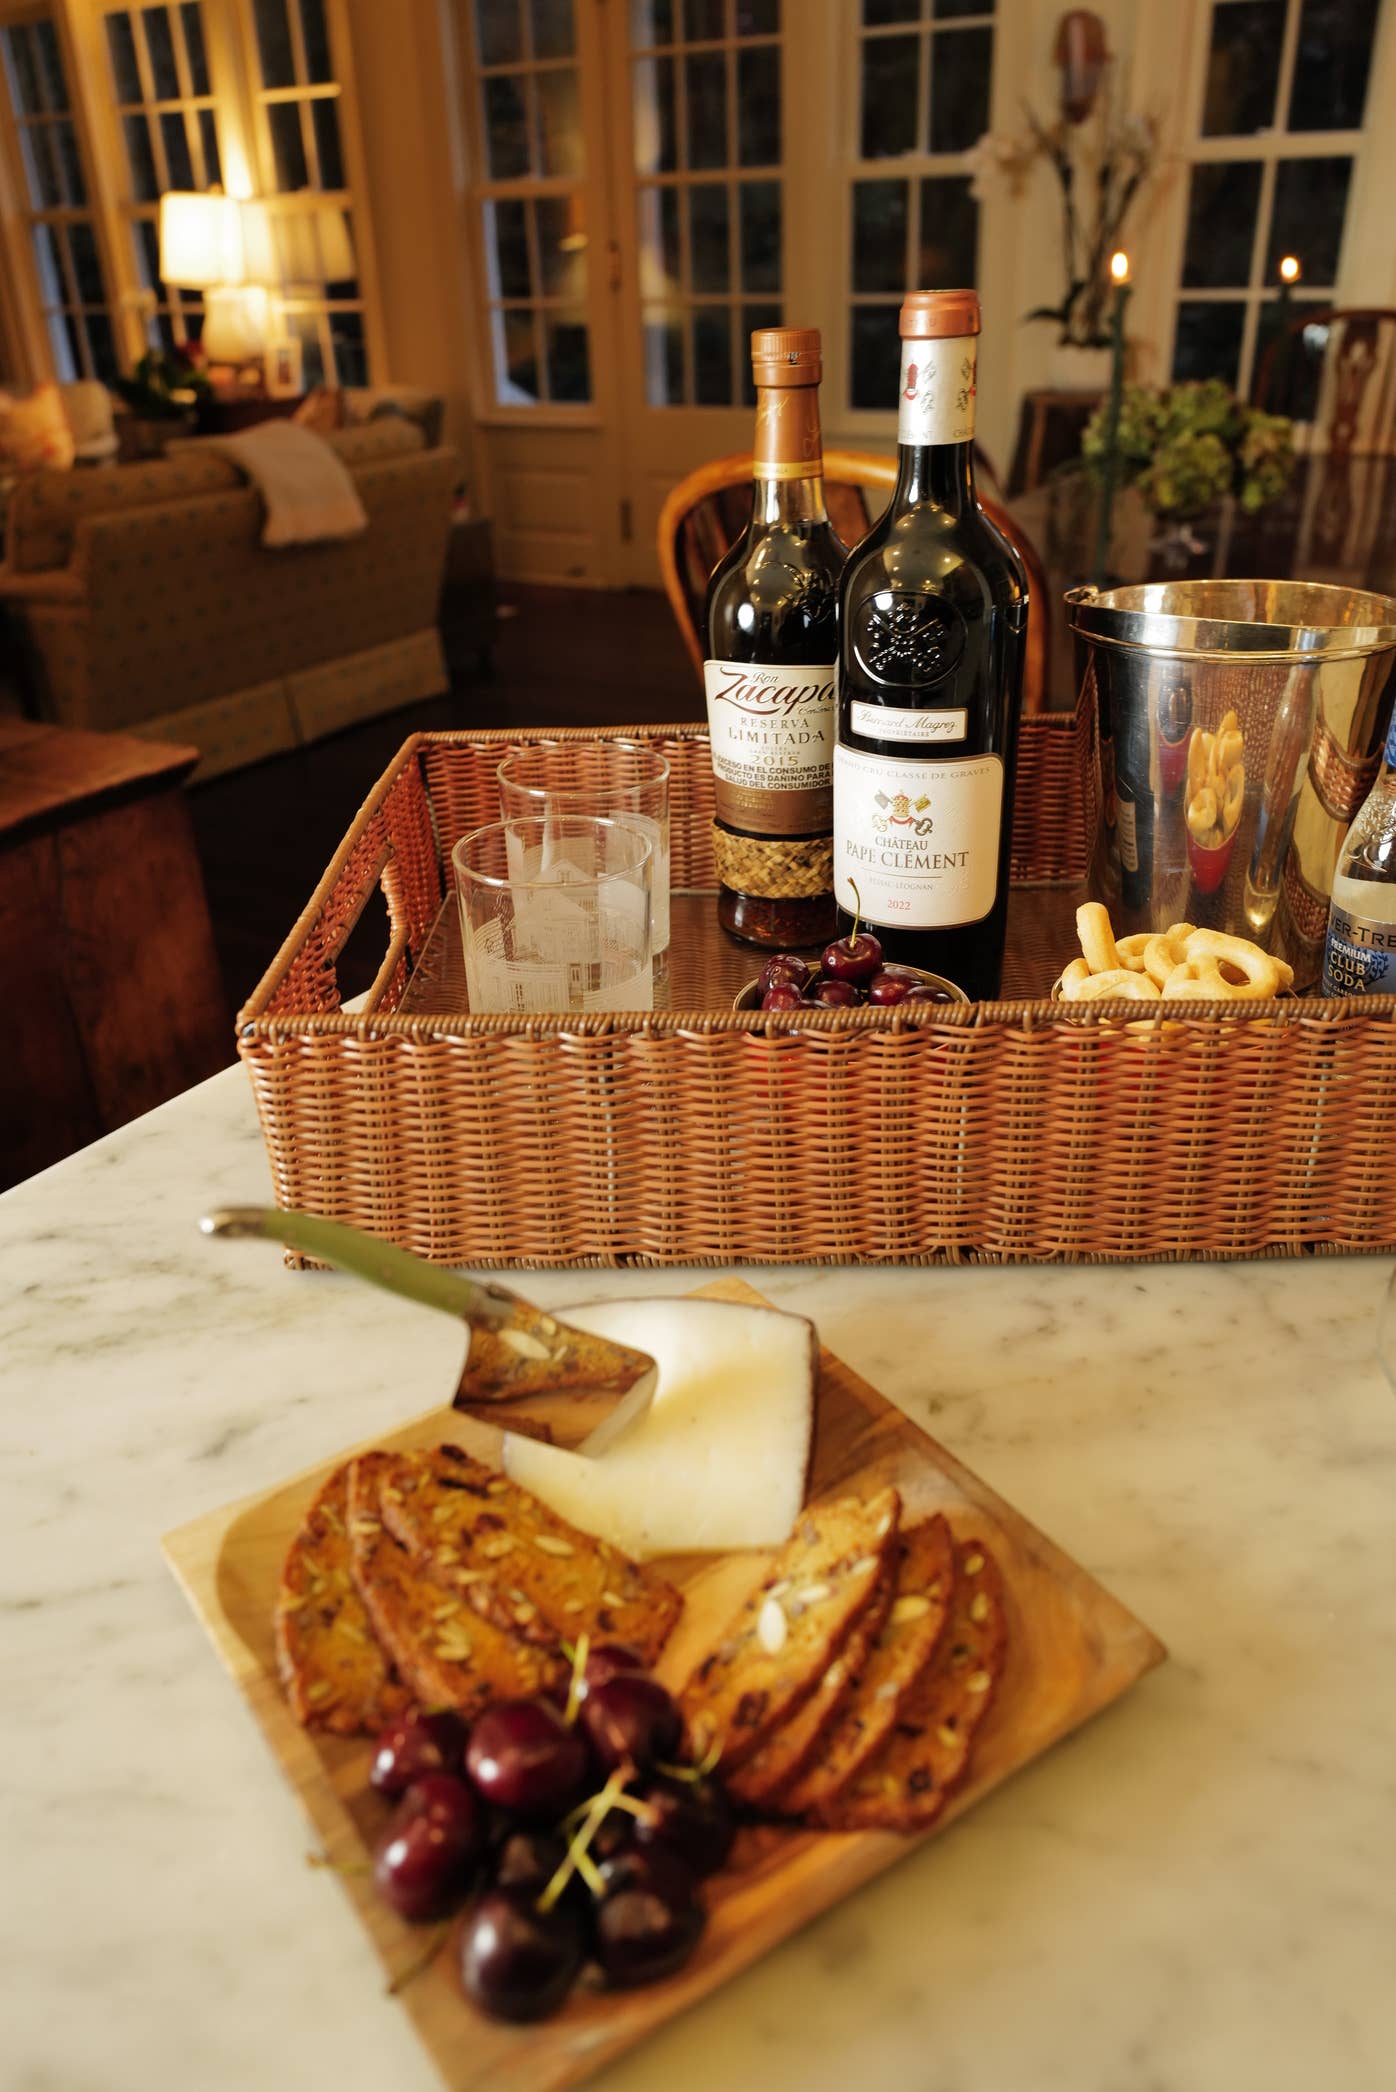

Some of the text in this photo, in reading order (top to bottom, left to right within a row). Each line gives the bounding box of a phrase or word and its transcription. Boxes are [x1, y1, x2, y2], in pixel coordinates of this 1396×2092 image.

[753, 672, 779, 684] Ron
[741, 717, 809, 728] RESERVA
[905, 716, 958, 733] Magrez
[729, 727, 825, 744] LIMITADA
[752, 755, 799, 766] 2015
[744, 764, 755, 772] EN
[757, 766, 767, 774] EL
[769, 764, 817, 775] CONSUMO
[819, 762, 830, 771] DE
[931, 772, 947, 780] DE
[950, 767, 991, 778] GRAVES
[754, 773, 766, 781] ES
[807, 771, 830, 780] PARA
[749, 780, 766, 789] DEL
[767, 778, 831, 790] CONSUMIDOR
[875, 836, 928, 850] CHÂTEAU
[846, 839, 969, 869] PAPE CLÉMENT
[887, 899, 911, 911] 2022
[1331, 937, 1371, 963] PREMIUM
[1330, 951, 1366, 976] CLUB
[1328, 964, 1367, 992] SODA
